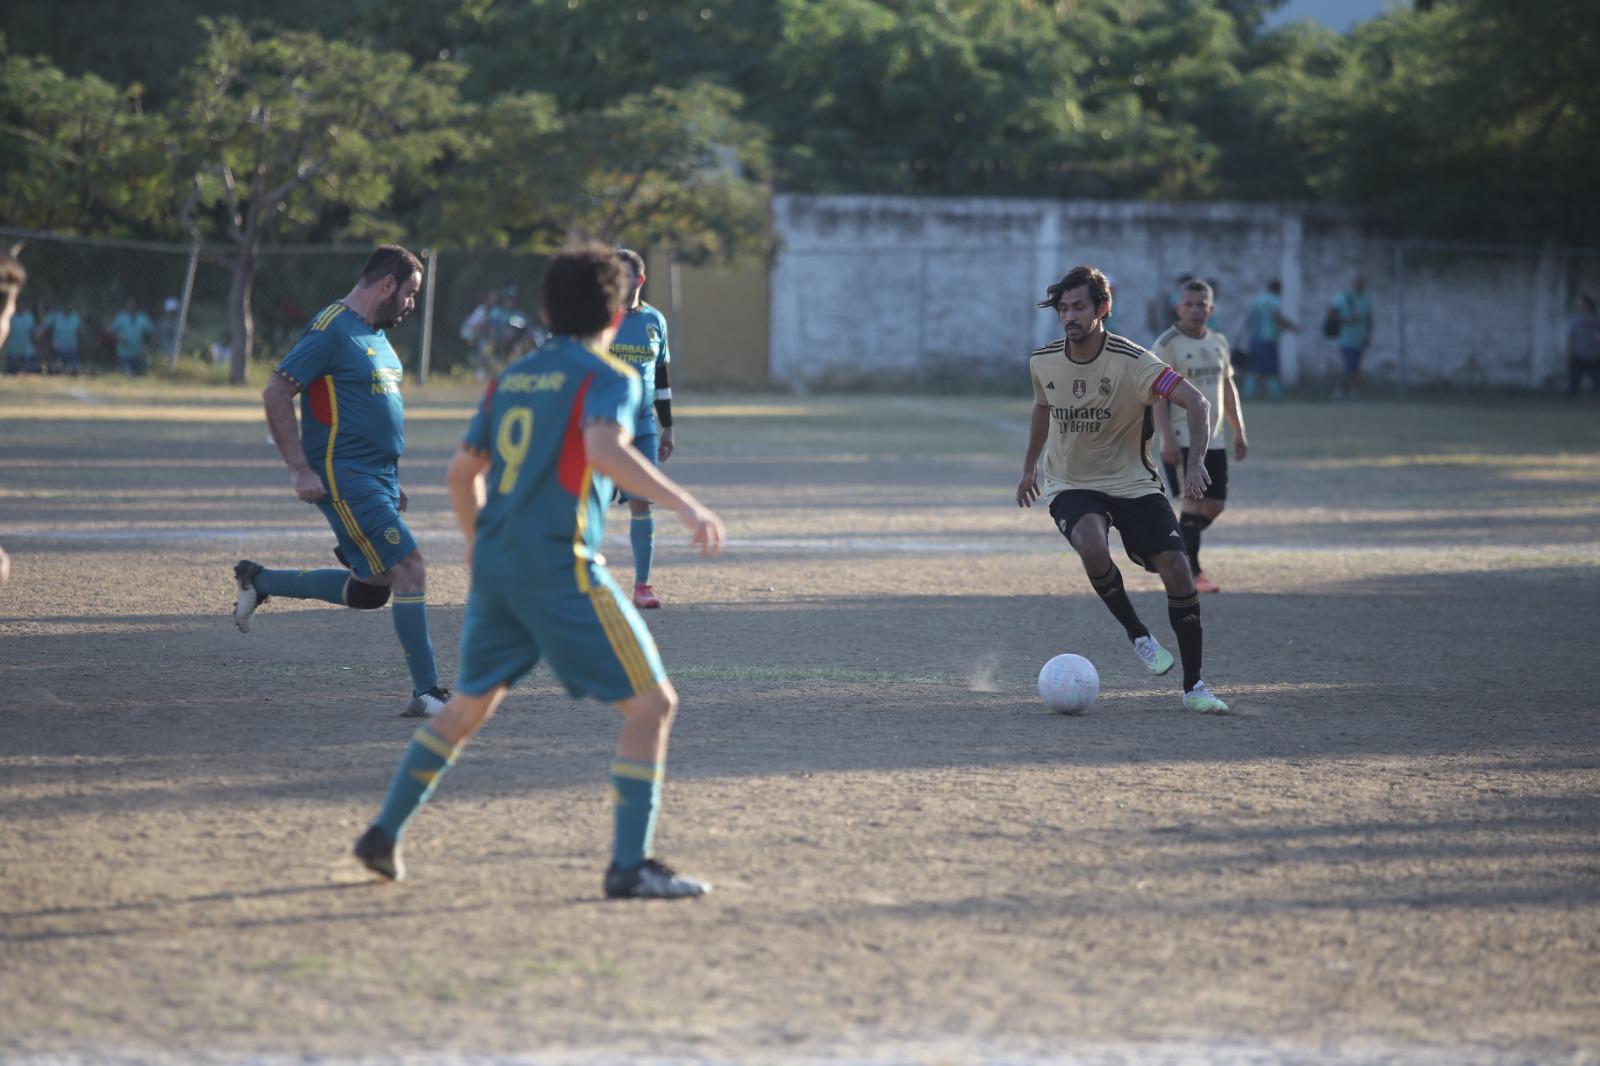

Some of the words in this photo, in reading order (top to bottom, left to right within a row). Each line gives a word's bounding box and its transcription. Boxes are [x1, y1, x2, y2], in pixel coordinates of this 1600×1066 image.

[1049, 404, 1112, 419] Emirates
[1070, 421, 1101, 433] BETTER
[496, 406, 534, 494] 9
